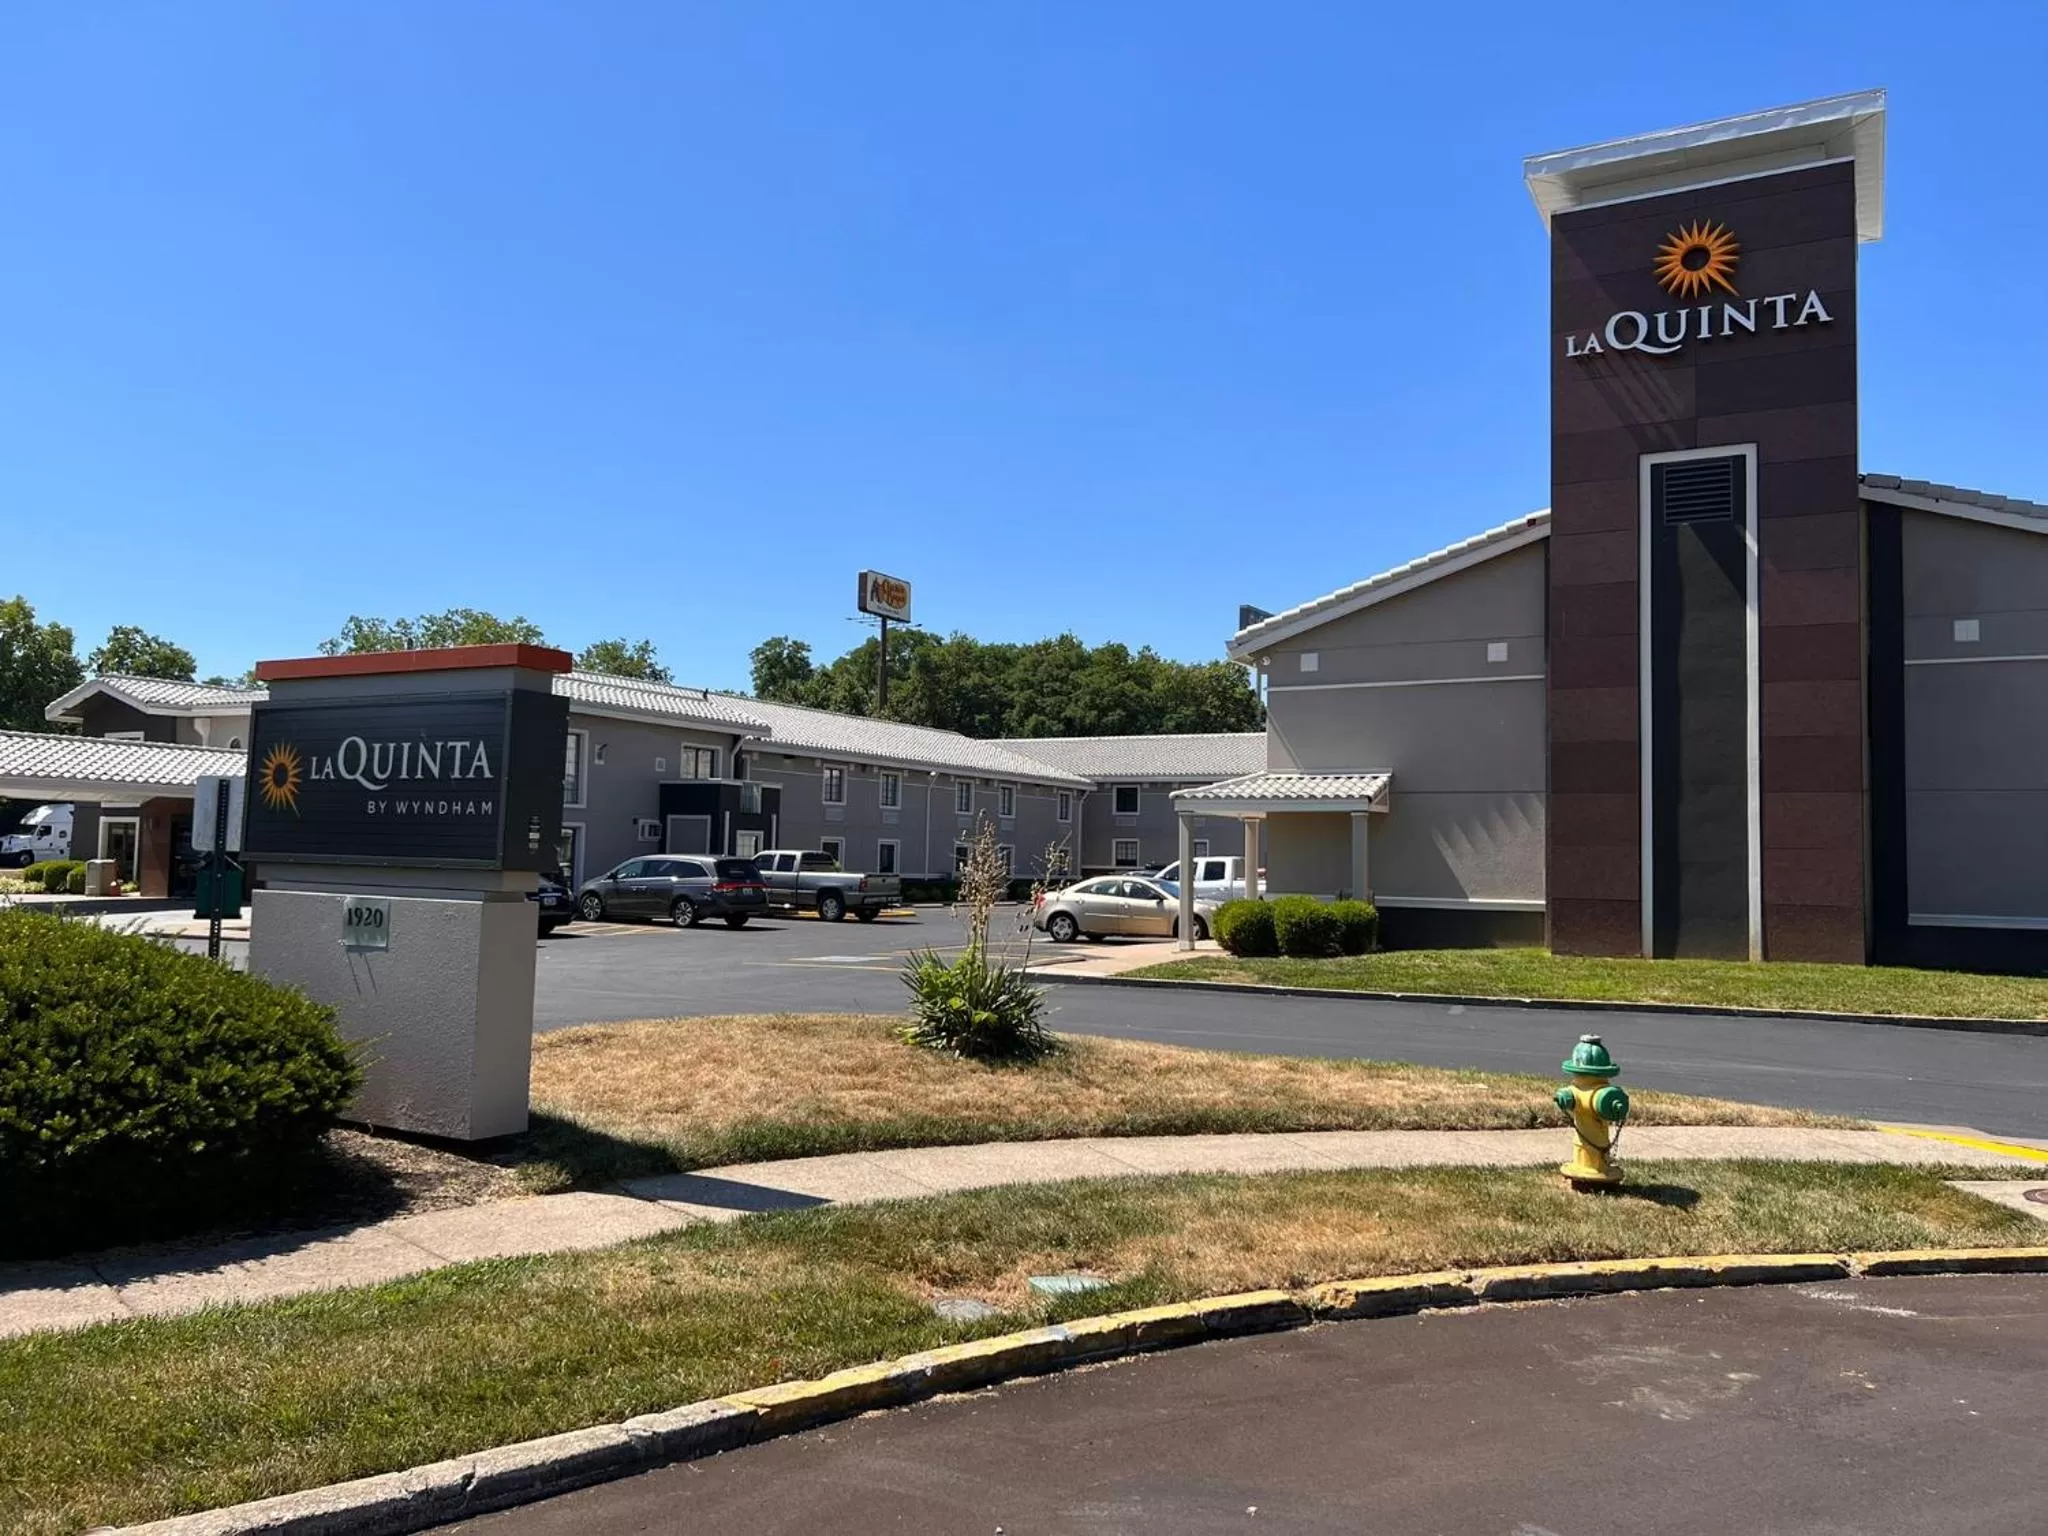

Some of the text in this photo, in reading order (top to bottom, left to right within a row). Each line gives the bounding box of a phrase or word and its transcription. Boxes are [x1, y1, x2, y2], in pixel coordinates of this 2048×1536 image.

[1566, 289, 1834, 358] LA QUINTA
[309, 735, 494, 791] LA QUINTA
[367, 800, 493, 815] BY WYNDHAM
[347, 907, 383, 928] 1920
